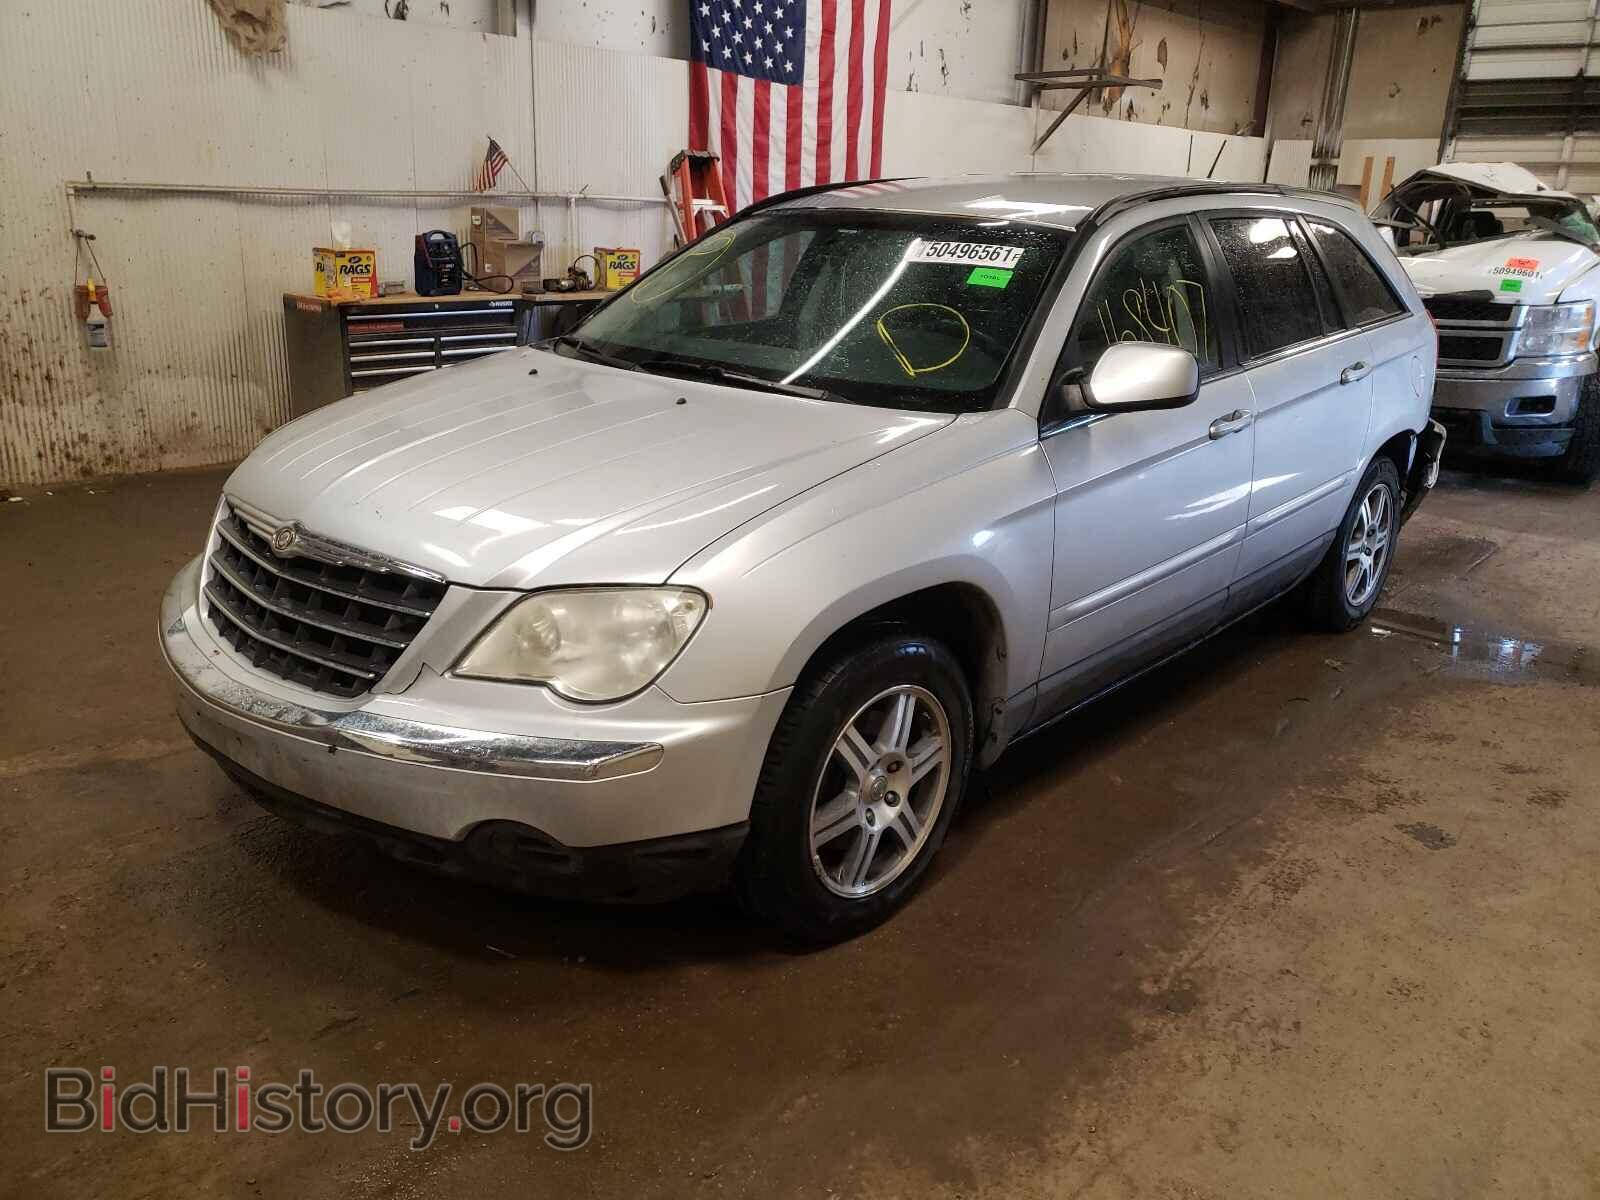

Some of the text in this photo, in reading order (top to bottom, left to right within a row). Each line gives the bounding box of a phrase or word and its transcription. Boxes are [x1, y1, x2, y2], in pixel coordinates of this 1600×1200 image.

[926, 242, 1014, 262] 50496561
[340, 264, 371, 274] RAGS
[609, 260, 636, 270] RAGS
